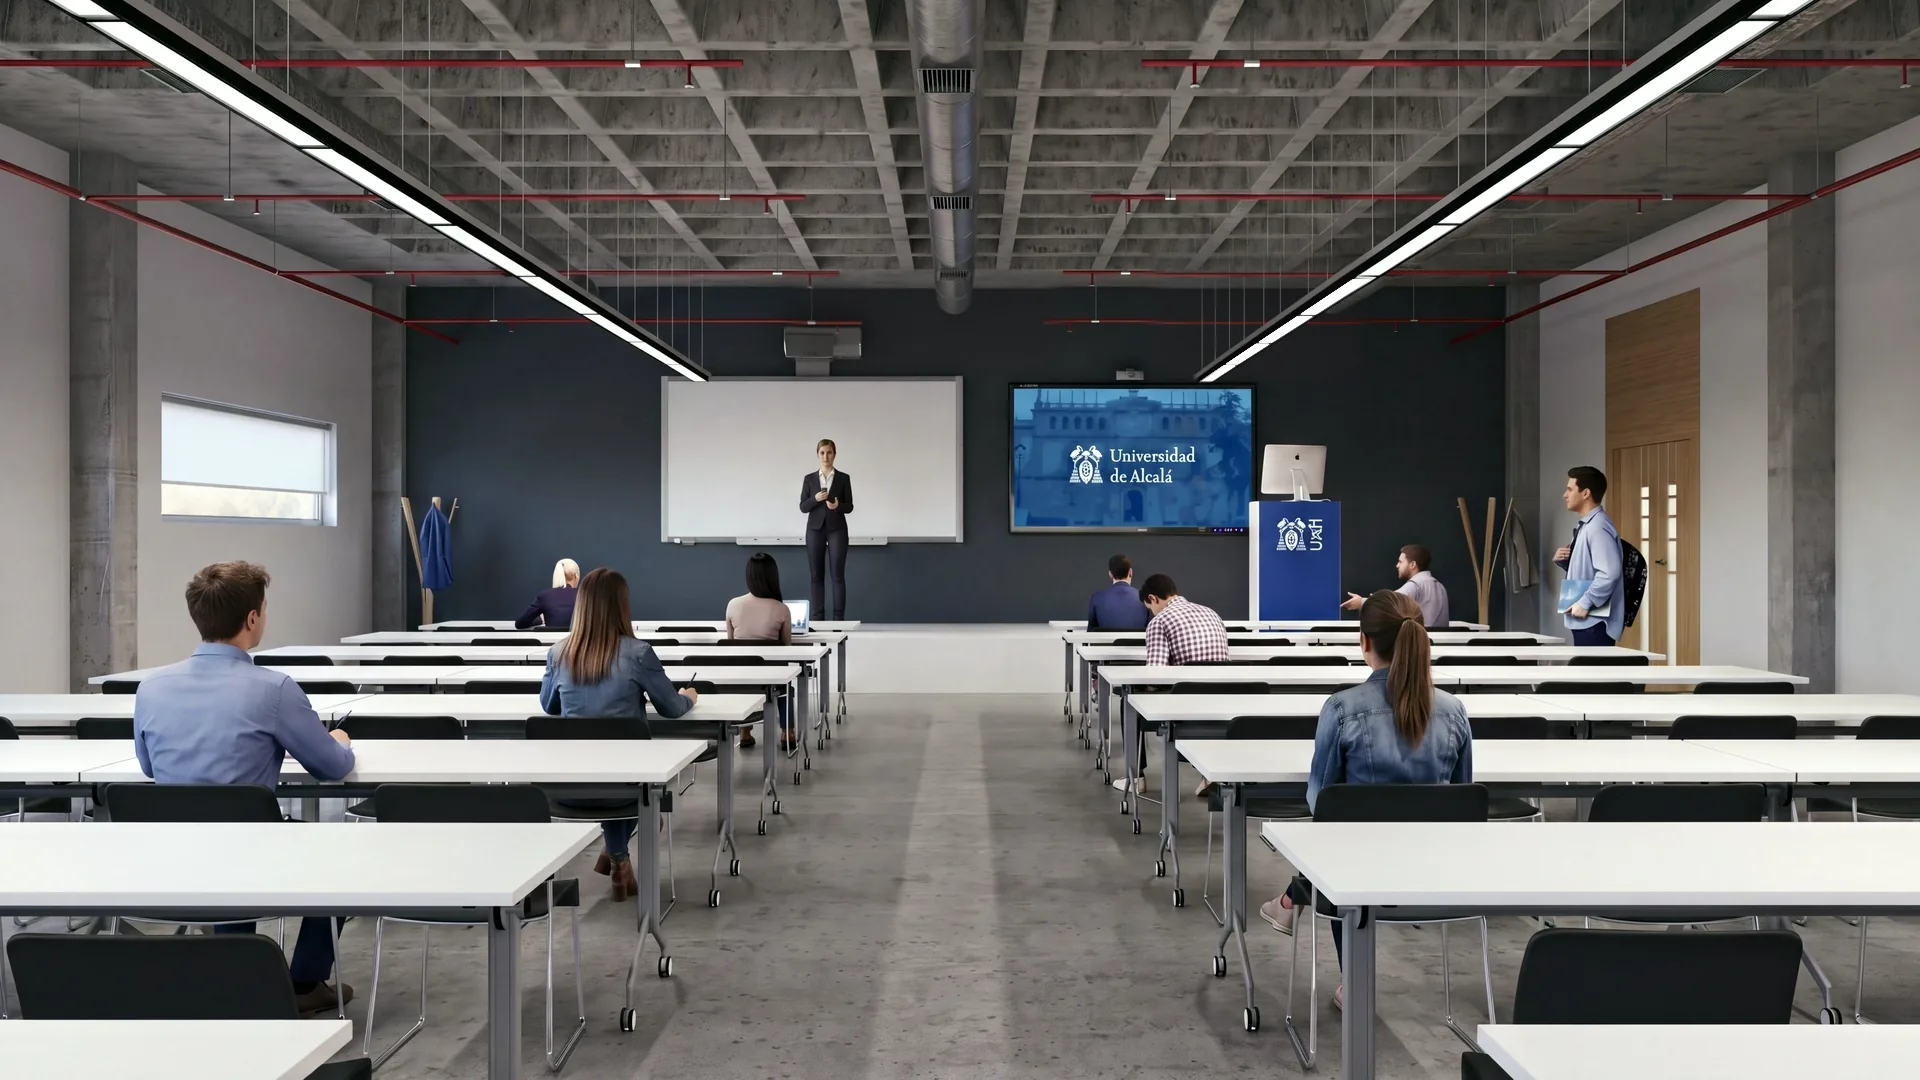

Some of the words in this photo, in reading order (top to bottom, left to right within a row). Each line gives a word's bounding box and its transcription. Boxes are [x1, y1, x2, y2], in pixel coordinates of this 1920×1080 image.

[1110, 446, 1196, 463] Universidad
[1110, 467, 1128, 483] de
[1130, 467, 1173, 484] Alcalá
